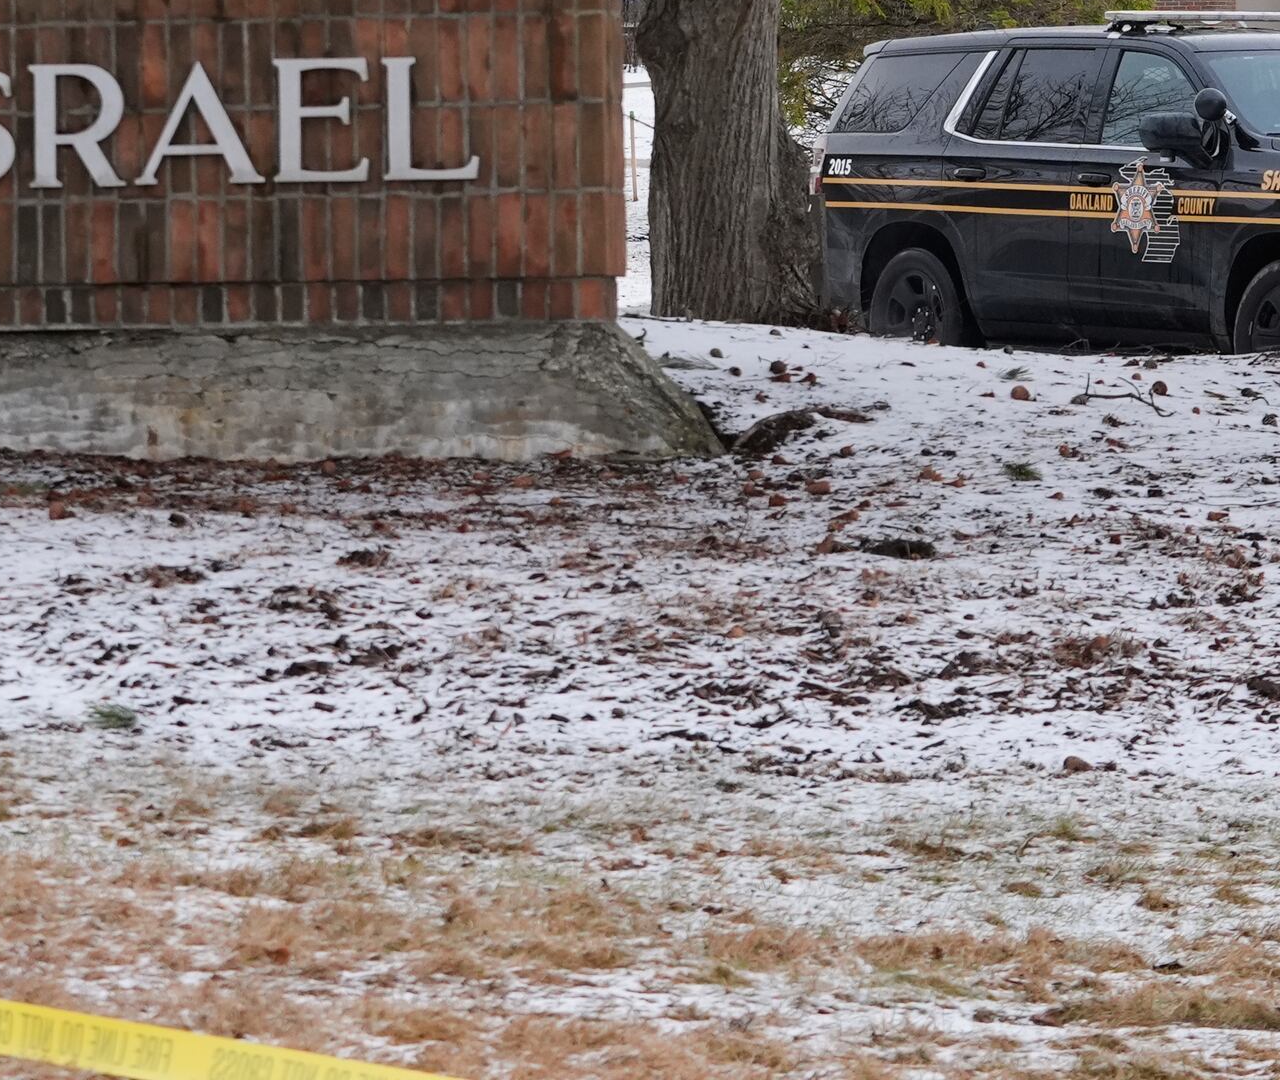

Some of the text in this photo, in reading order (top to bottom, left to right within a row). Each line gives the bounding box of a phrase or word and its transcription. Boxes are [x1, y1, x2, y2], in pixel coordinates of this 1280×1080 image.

[828, 158, 852, 175] 2015
[1070, 192, 1215, 215] OAKLAND COUNTY
